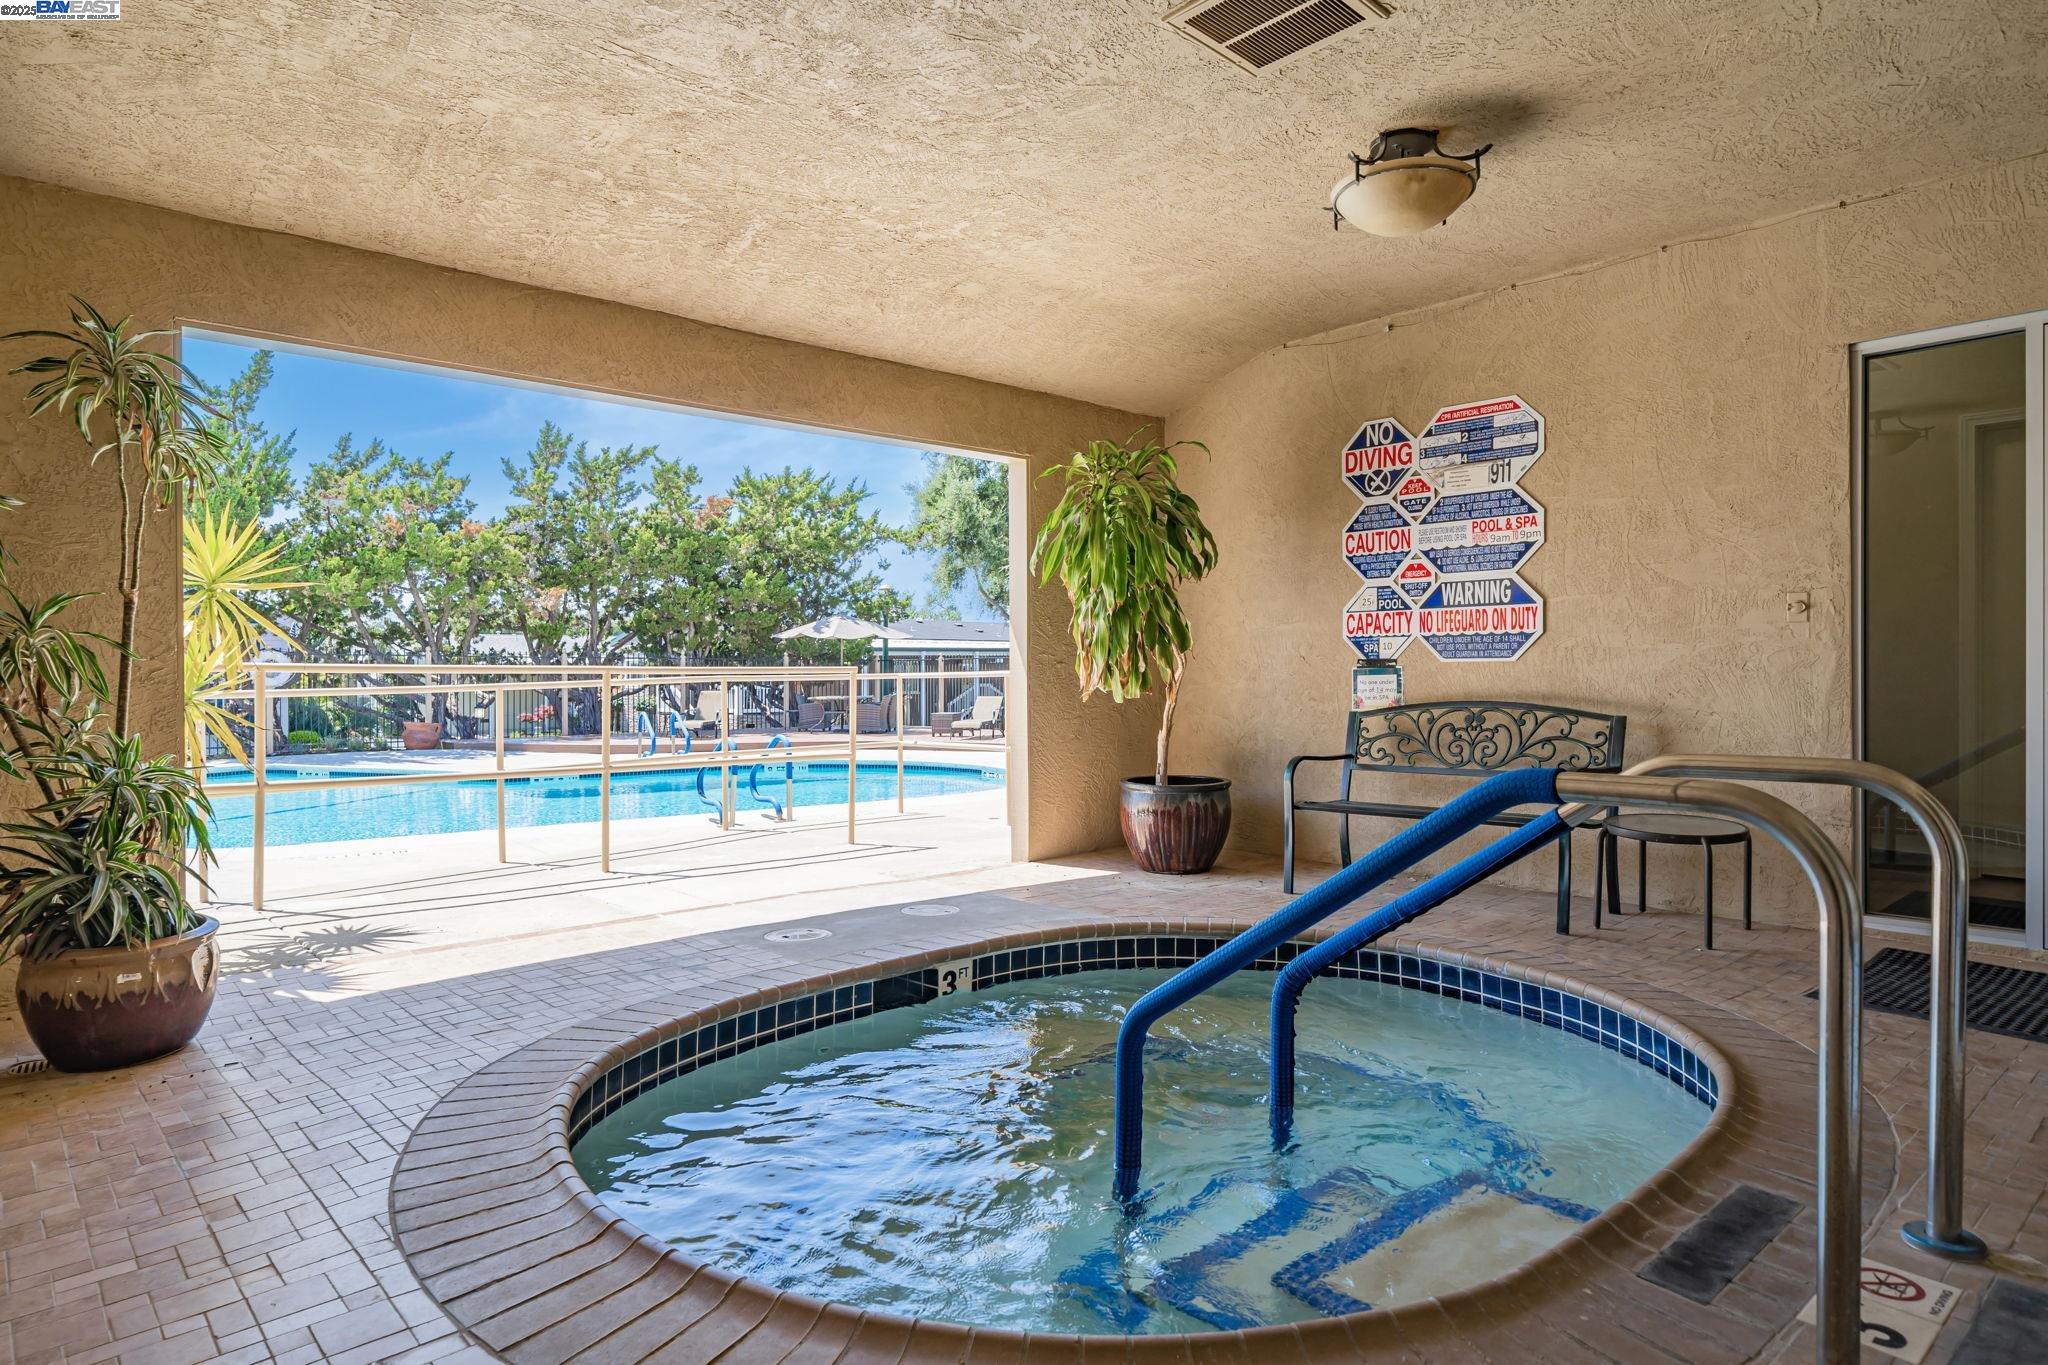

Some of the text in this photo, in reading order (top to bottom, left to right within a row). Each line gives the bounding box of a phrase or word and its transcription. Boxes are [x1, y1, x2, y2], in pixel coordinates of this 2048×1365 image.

[1440, 412, 1452, 420] CPR
[1480, 402, 1514, 414] RESPIRATION
[1366, 421, 1394, 447] NO
[1462, 432, 1468, 442] 2
[1346, 442, 1412, 474] DIVING
[1420, 448, 1426, 458] 3
[1461, 454, 1468, 464] 4
[1490, 459, 1512, 484] 911
[1472, 516, 1538, 532] POOL & SPA
[1346, 528, 1411, 554] CAUTION
[1490, 533, 1510, 542] 9am
[1512, 530, 1518, 540] TO
[1520, 530, 1542, 540] 9pm
[1442, 580, 1512, 606] WARNING
[1378, 599, 1404, 610] POOL
[1346, 611, 1413, 635] CAPACITY
[1420, 606, 1538, 632] NO LIFEGUARD ON DUTY
[1364, 644, 1378, 652] SPA
[1383, 642, 1392, 650] 10
[942, 966, 969, 996] 3 FT
[1928, 1289, 1954, 1316] NO DIVING
